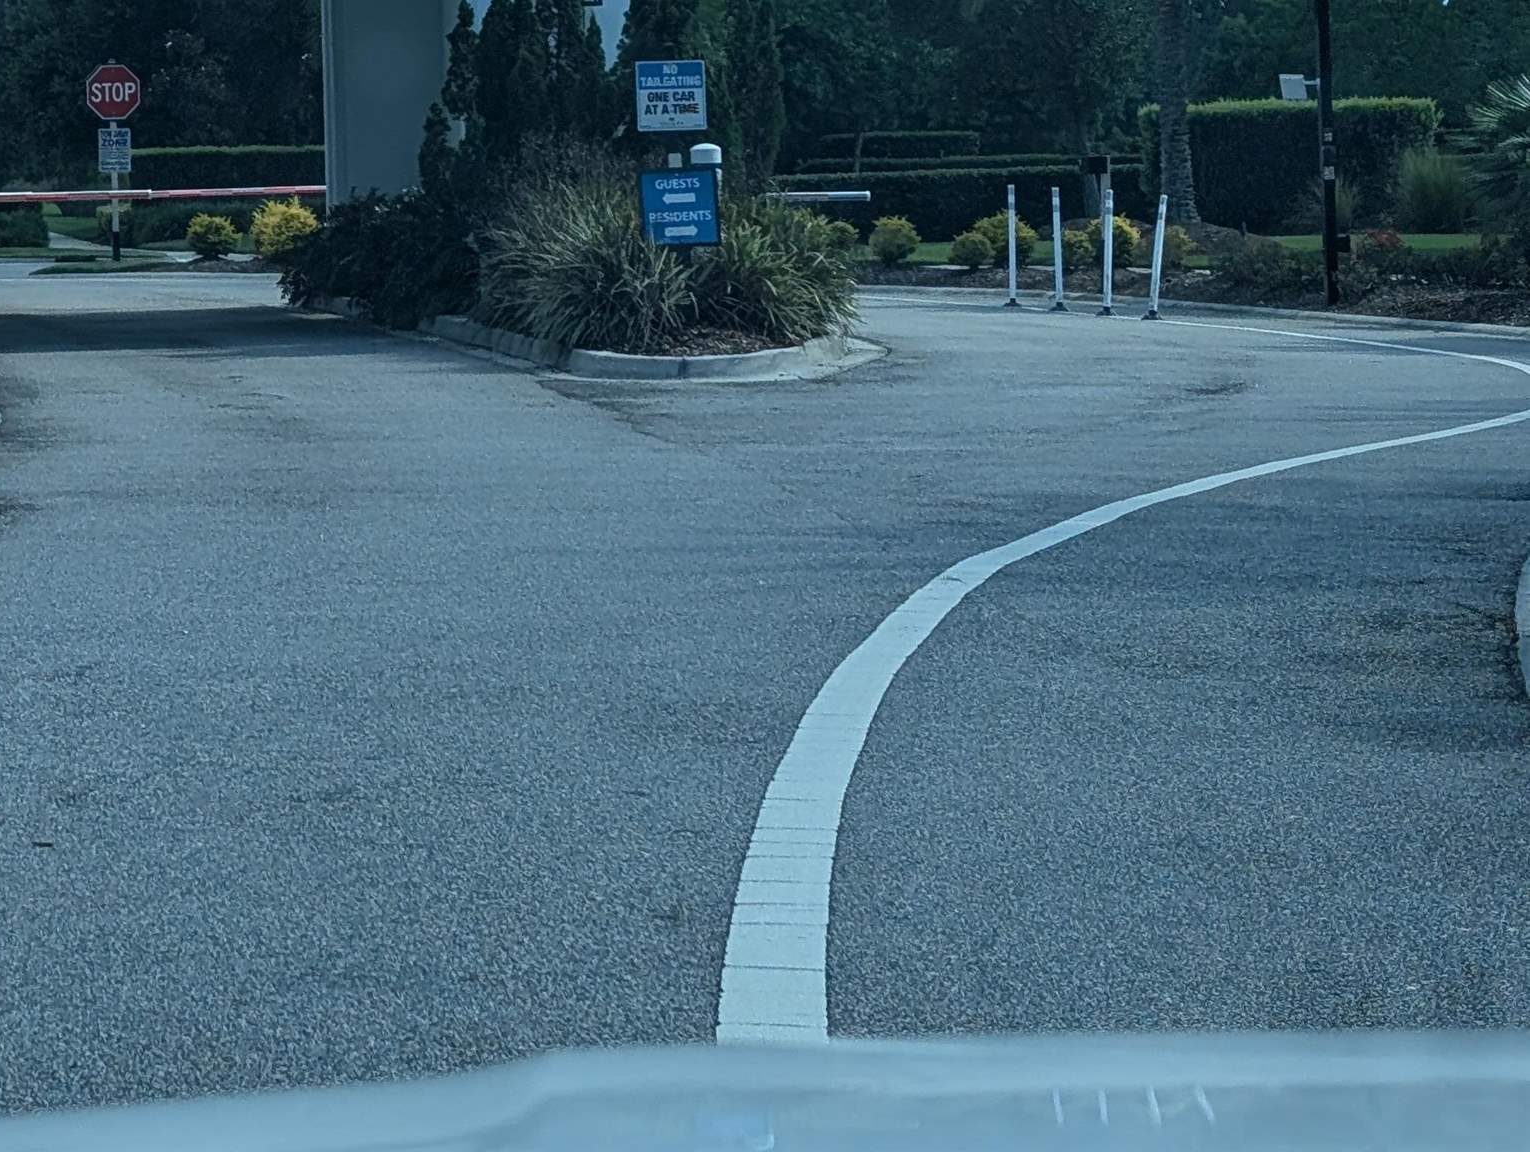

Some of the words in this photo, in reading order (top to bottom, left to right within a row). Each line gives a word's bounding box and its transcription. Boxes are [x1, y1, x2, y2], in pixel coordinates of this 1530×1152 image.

[662, 64, 678, 74] NO
[640, 75, 702, 87] TAILGATING
[91, 82, 136, 103] STOP
[647, 92, 670, 102] ONE
[672, 91, 695, 102] CAR
[645, 104, 658, 115] AT
[661, 104, 670, 115] A
[654, 177, 701, 190] GUESTS
[649, 210, 713, 223] RESIDENTS
